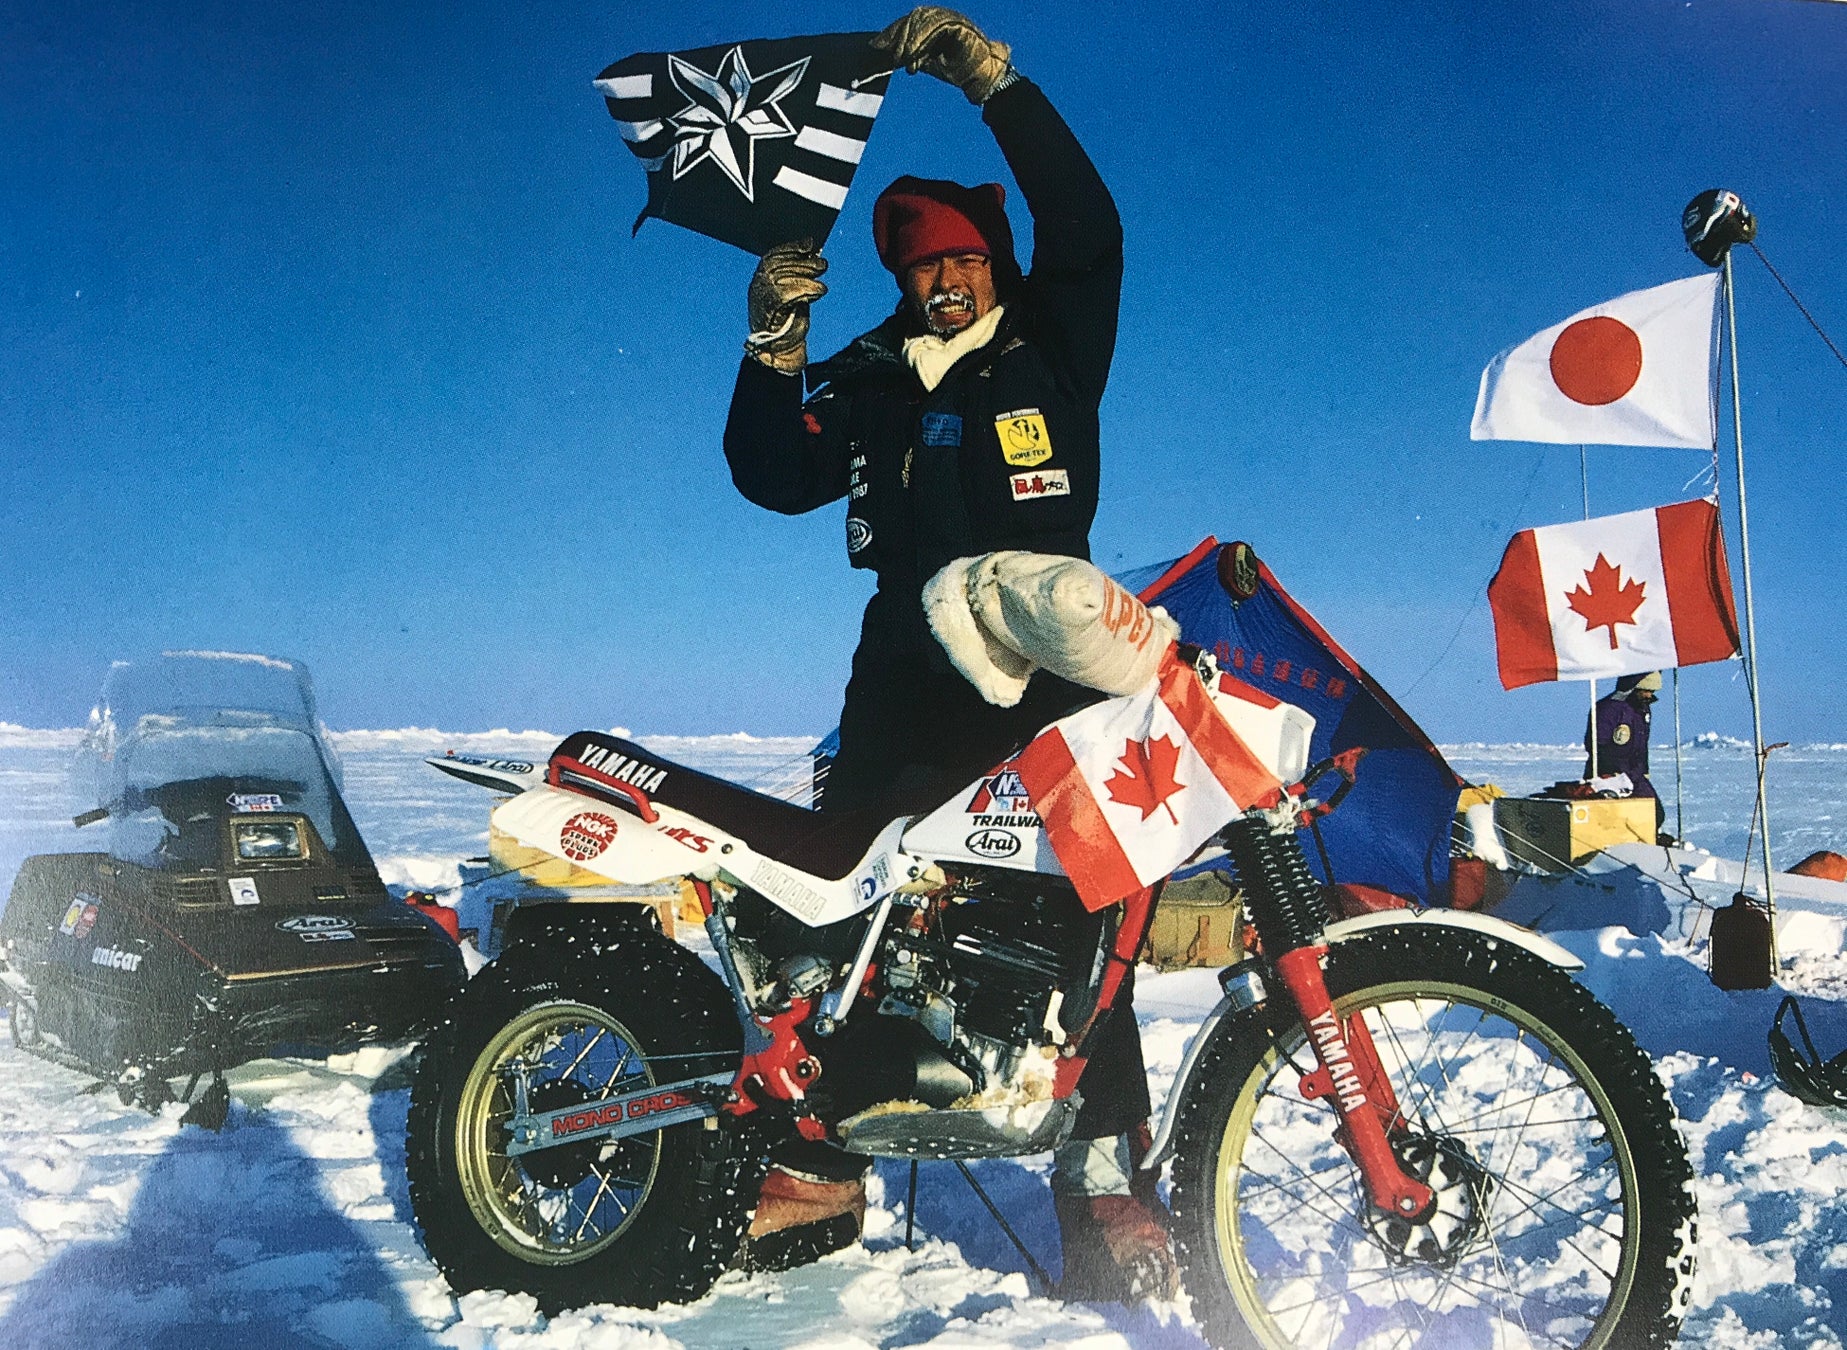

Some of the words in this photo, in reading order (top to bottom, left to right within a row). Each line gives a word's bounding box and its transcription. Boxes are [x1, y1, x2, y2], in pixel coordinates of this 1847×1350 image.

[578, 743, 668, 794] YAMAHA
[569, 830, 599, 848] SPARK
[574, 816, 612, 837] NGK
[563, 838, 594, 856] PLUGS
[967, 832, 1014, 850] Arai
[750, 858, 827, 921] YAMAHA
[1310, 1010, 1366, 1113] YAMAHA
[552, 1104, 623, 1135] MONO
